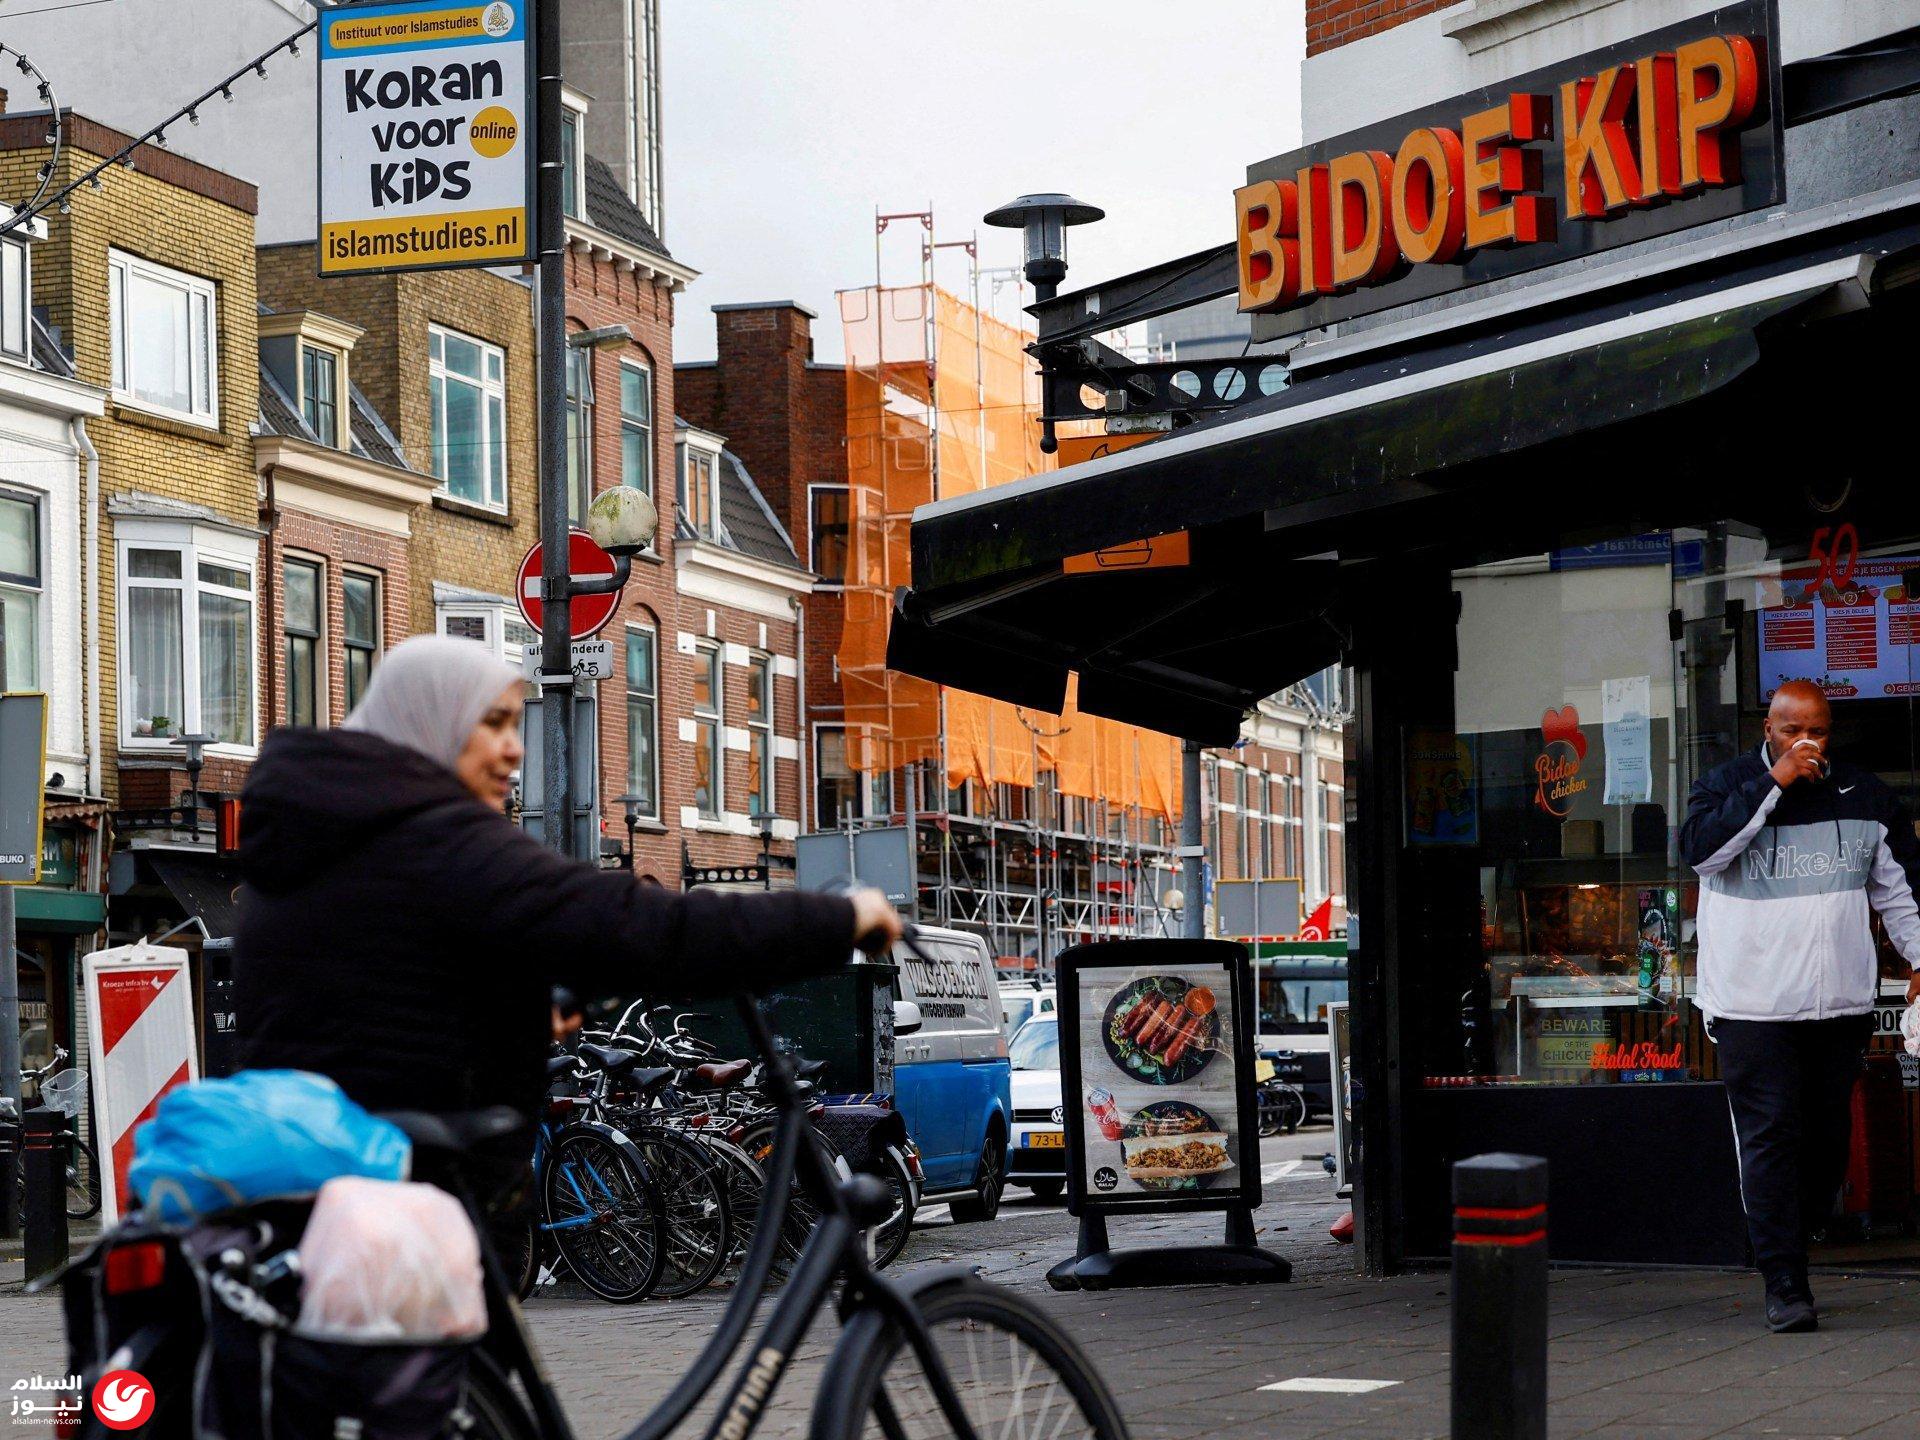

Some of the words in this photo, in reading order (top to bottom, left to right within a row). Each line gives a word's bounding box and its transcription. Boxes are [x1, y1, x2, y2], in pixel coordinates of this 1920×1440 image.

[336, 24, 382, 41] Instituut
[384, 25, 407, 36] voor
[410, 16, 479, 34] Islamstudies
[371, 116, 466, 152] voor
[470, 122, 516, 140] online
[1234, 93, 1556, 313] BIDOE
[1560, 34, 1758, 221] KIP
[329, 216, 518, 259] islamstudies.nl
[1870, 565, 1895, 574] EIGEN
[529, 643, 605, 656] uitnderd
[1822, 687, 1853, 697] WKOST
[1551, 776, 1588, 800] chicken
[1541, 1018, 1613, 1033] BEWARE
[1542, 1050, 1595, 1062] CHICKE
[1590, 1042, 1639, 1070] Halal
[1640, 1042, 1682, 1069] Food
